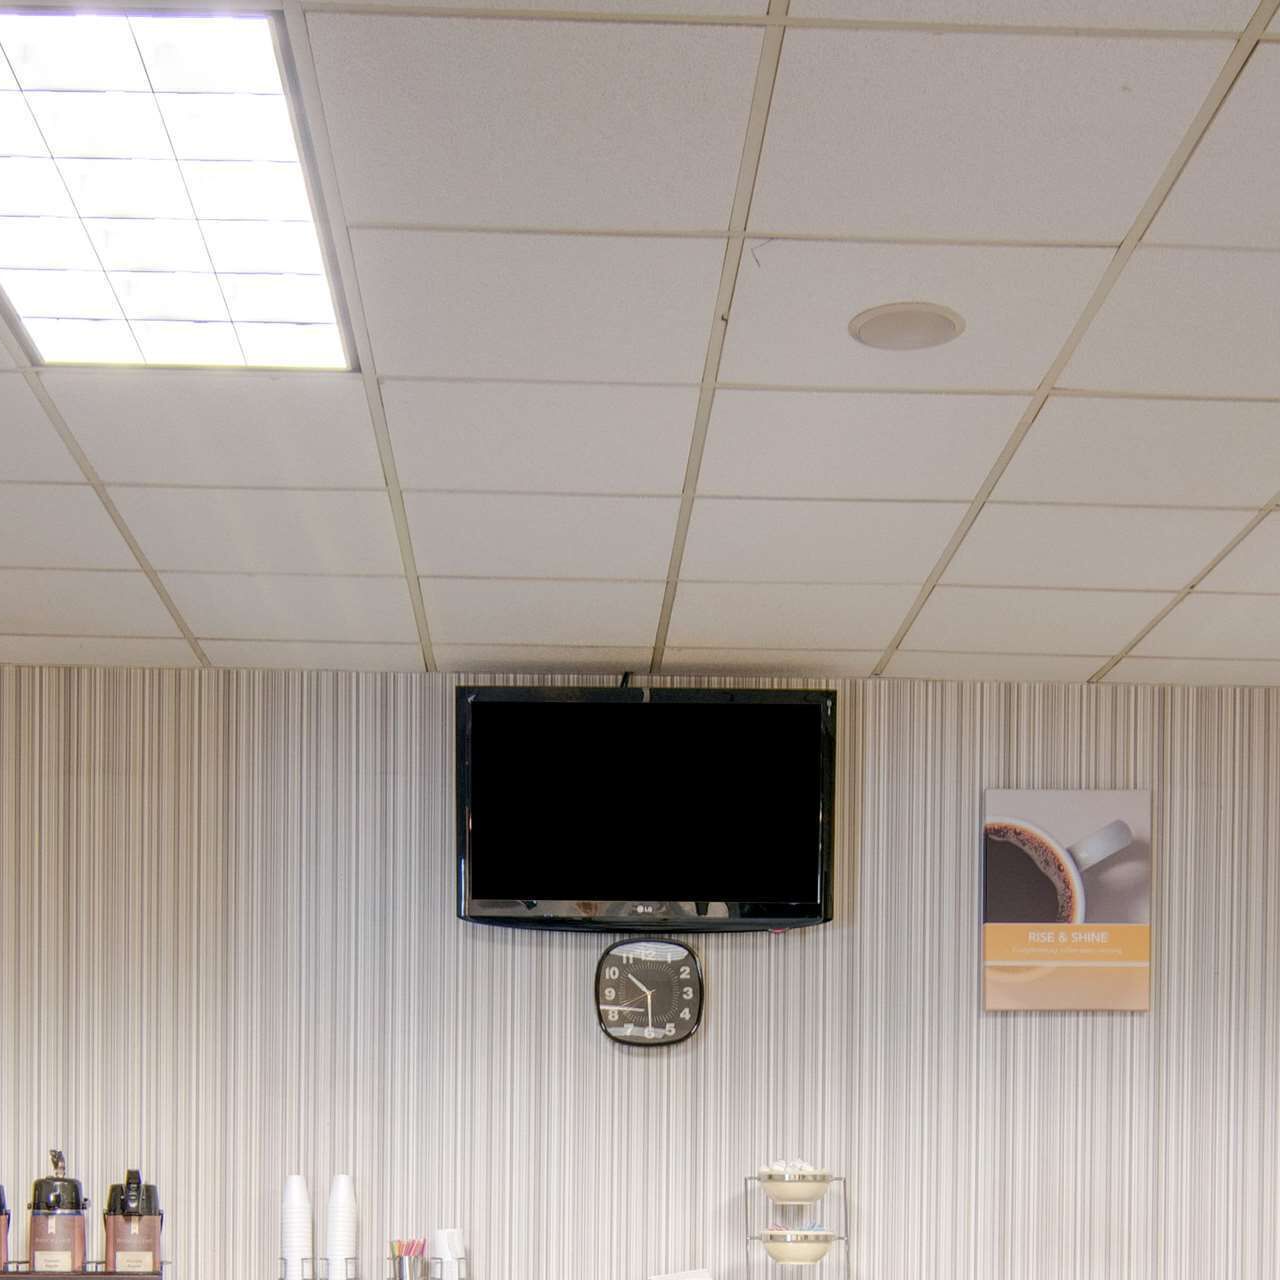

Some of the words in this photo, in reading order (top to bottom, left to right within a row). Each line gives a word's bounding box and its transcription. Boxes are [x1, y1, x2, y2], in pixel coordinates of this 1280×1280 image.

[1028, 931, 1055, 944] RISE
[1071, 931, 1110, 944] SHINE
[606, 966, 618, 979] 10
[680, 966, 690, 978] 2
[605, 988, 615, 1000] 9
[683, 987, 693, 999] 3
[608, 1010, 618, 1021] 8
[680, 1008, 690, 1020] 4
[624, 1024, 634, 1036] 7
[644, 1027, 654, 1038] 6
[666, 1023, 675, 1035] 5
